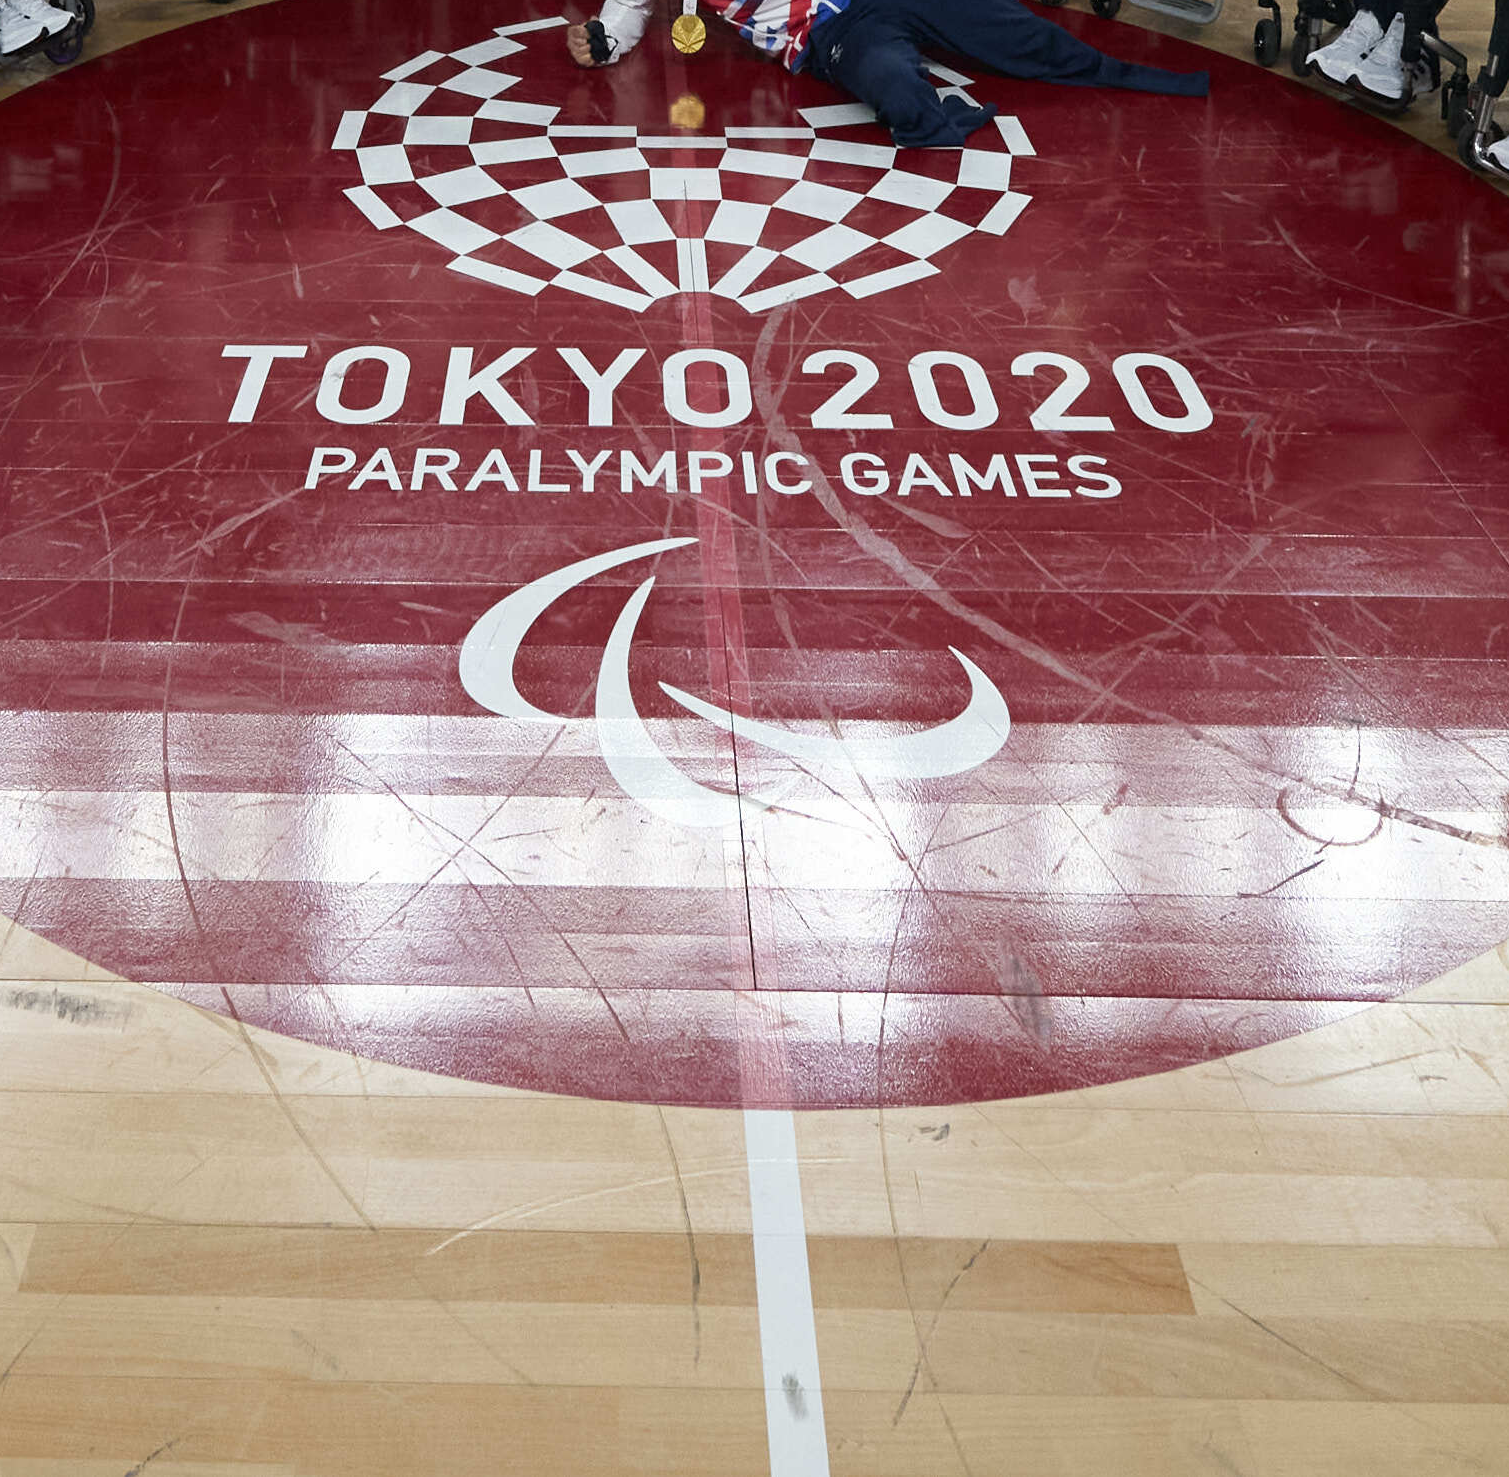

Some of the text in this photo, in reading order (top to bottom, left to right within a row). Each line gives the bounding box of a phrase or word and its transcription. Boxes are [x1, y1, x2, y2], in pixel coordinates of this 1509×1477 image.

[220, 343, 1214, 433] TOKYO 2020
[304, 446, 1123, 499] PARALYMPIC GAMES
